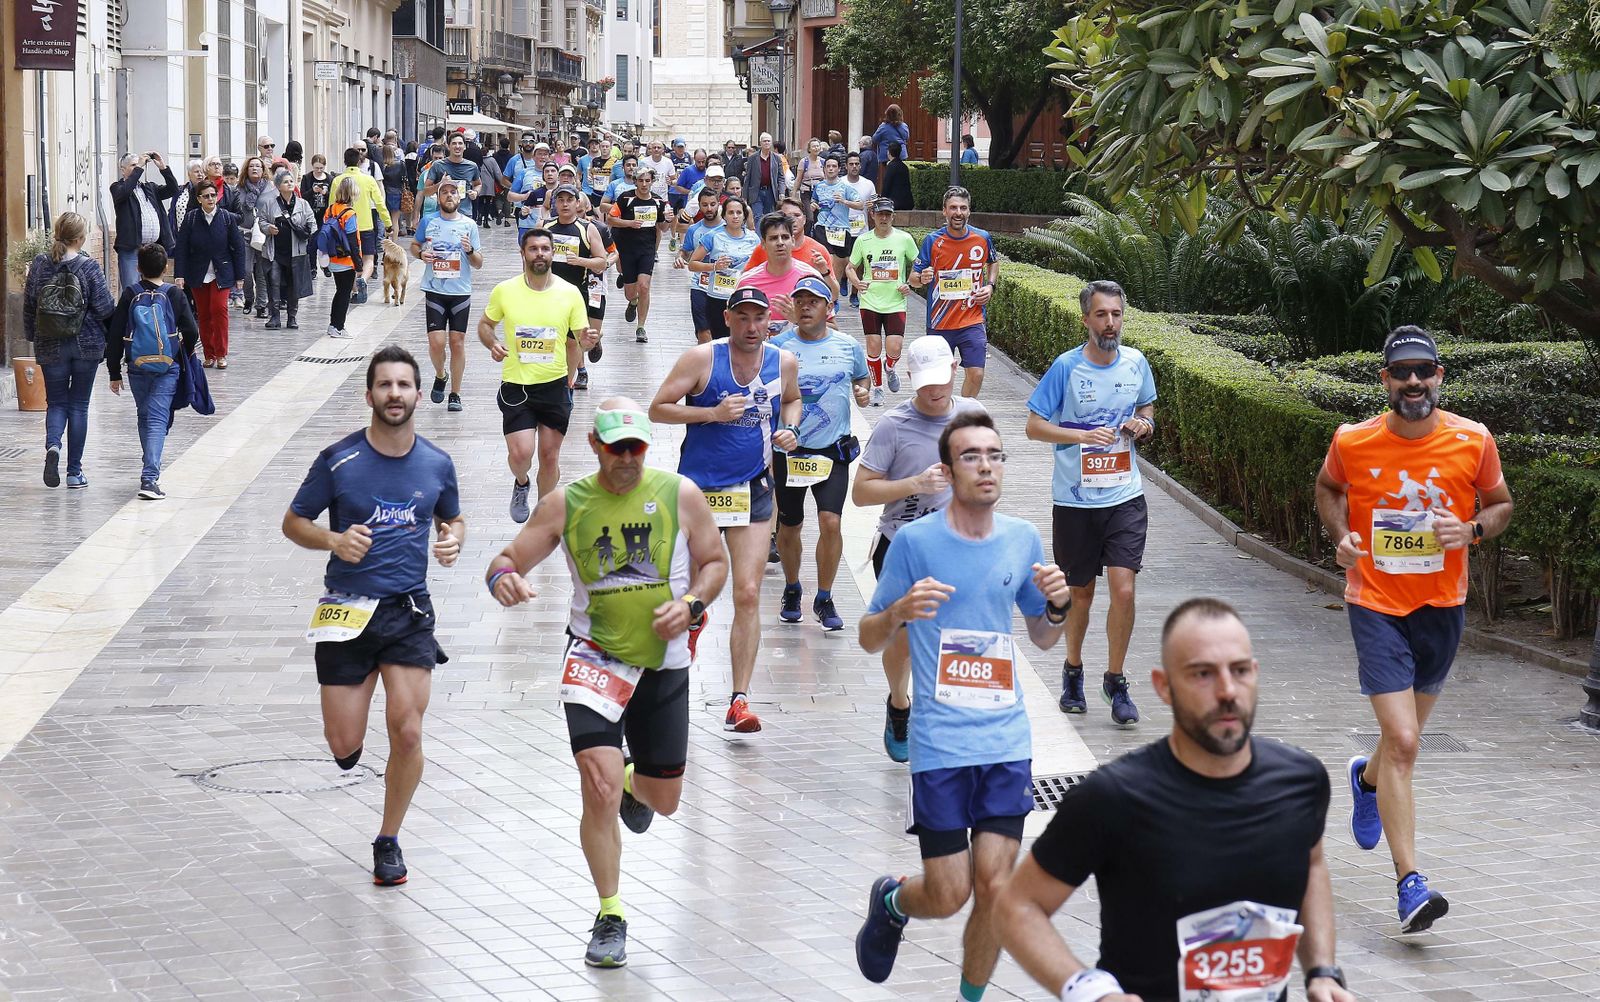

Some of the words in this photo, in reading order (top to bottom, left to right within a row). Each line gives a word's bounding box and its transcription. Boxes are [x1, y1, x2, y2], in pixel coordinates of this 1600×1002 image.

[22, 47, 53, 55] Handicraft
[54, 48, 69, 56] Shop
[450, 102, 472, 112] VANS
[718, 277, 735, 286] 7985
[943, 281, 963, 289] 6441
[520, 340, 544, 350] 8072
[793, 461, 818, 472] 7058
[1086, 456, 1118, 470] 3977
[1383, 535, 1425, 550] 7864
[319, 607, 350, 622] 6051
[946, 659, 993, 680] 4068
[568, 662, 609, 690] 3538
[1193, 946, 1265, 980] 3255
